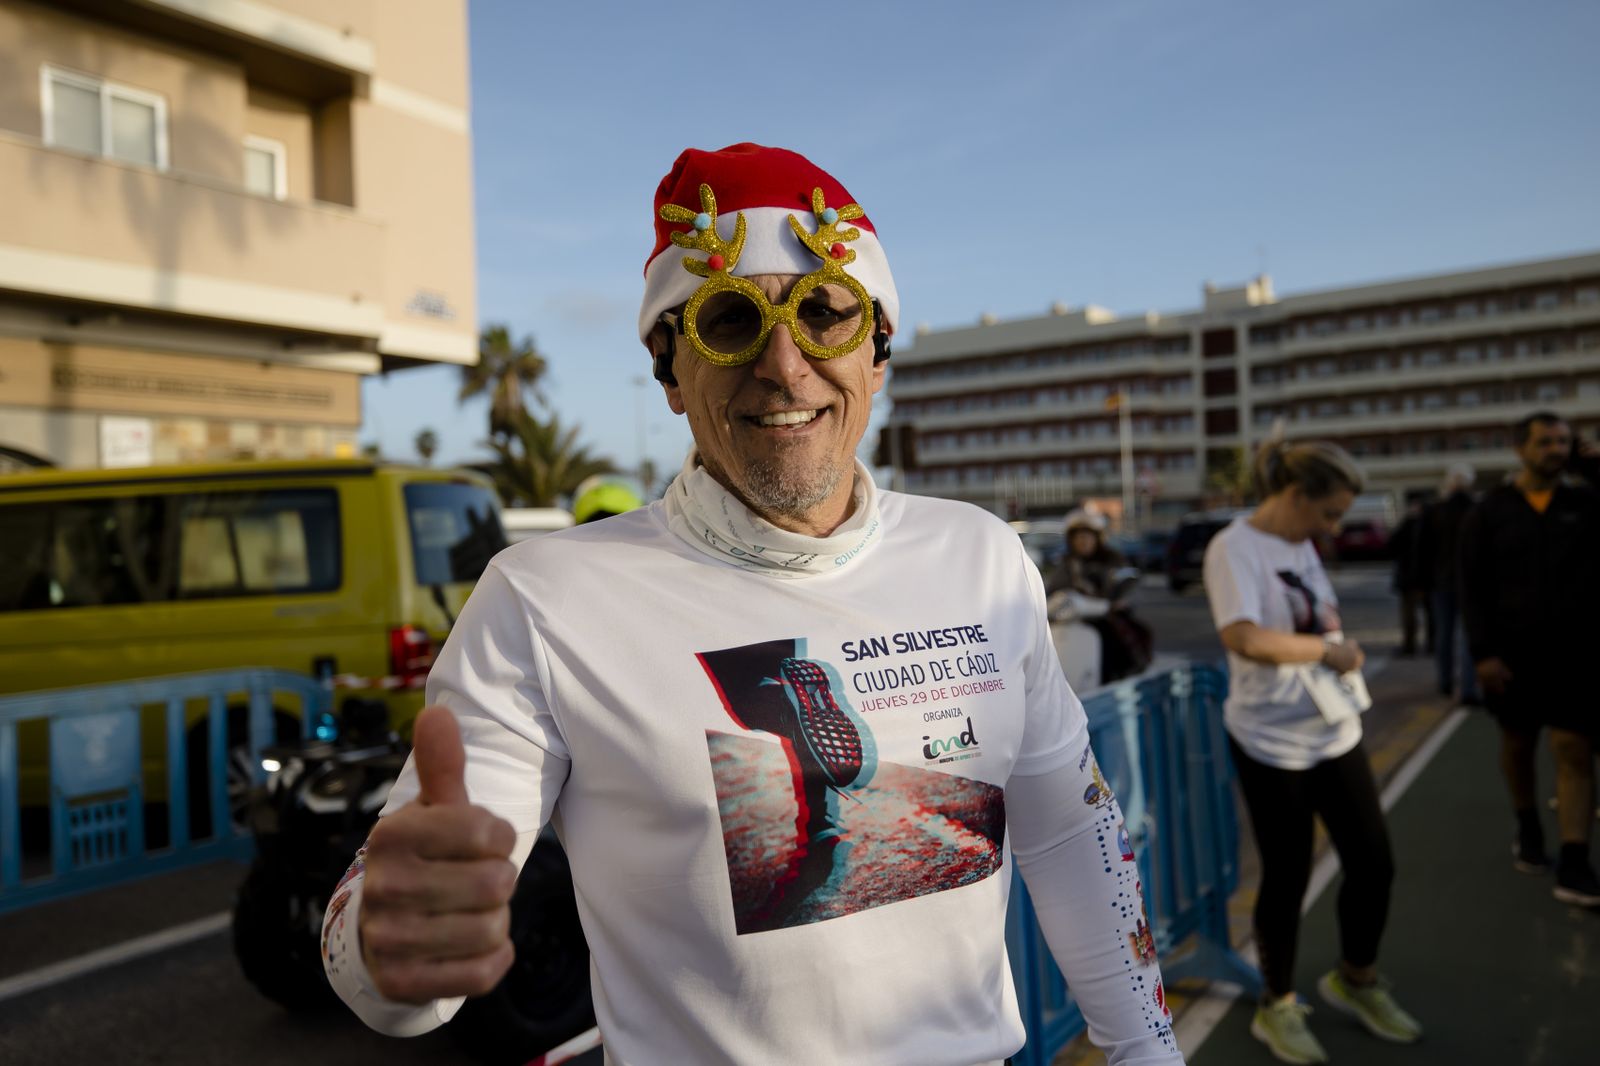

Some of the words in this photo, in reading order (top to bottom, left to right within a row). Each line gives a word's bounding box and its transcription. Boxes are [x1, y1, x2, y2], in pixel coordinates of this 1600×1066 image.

[841, 636, 890, 662] SAN
[892, 624, 989, 654] SILVESTRE
[853, 664, 926, 694] CIUDAD
[929, 659, 956, 682] DE
[956, 650, 1000, 677] CÁDIZ
[861, 694, 908, 713] JUEVES
[910, 691, 928, 705] 29
[930, 687, 949, 701] DE
[950, 679, 1006, 698] DICIEMBRE
[923, 707, 963, 722] ORGANIZA
